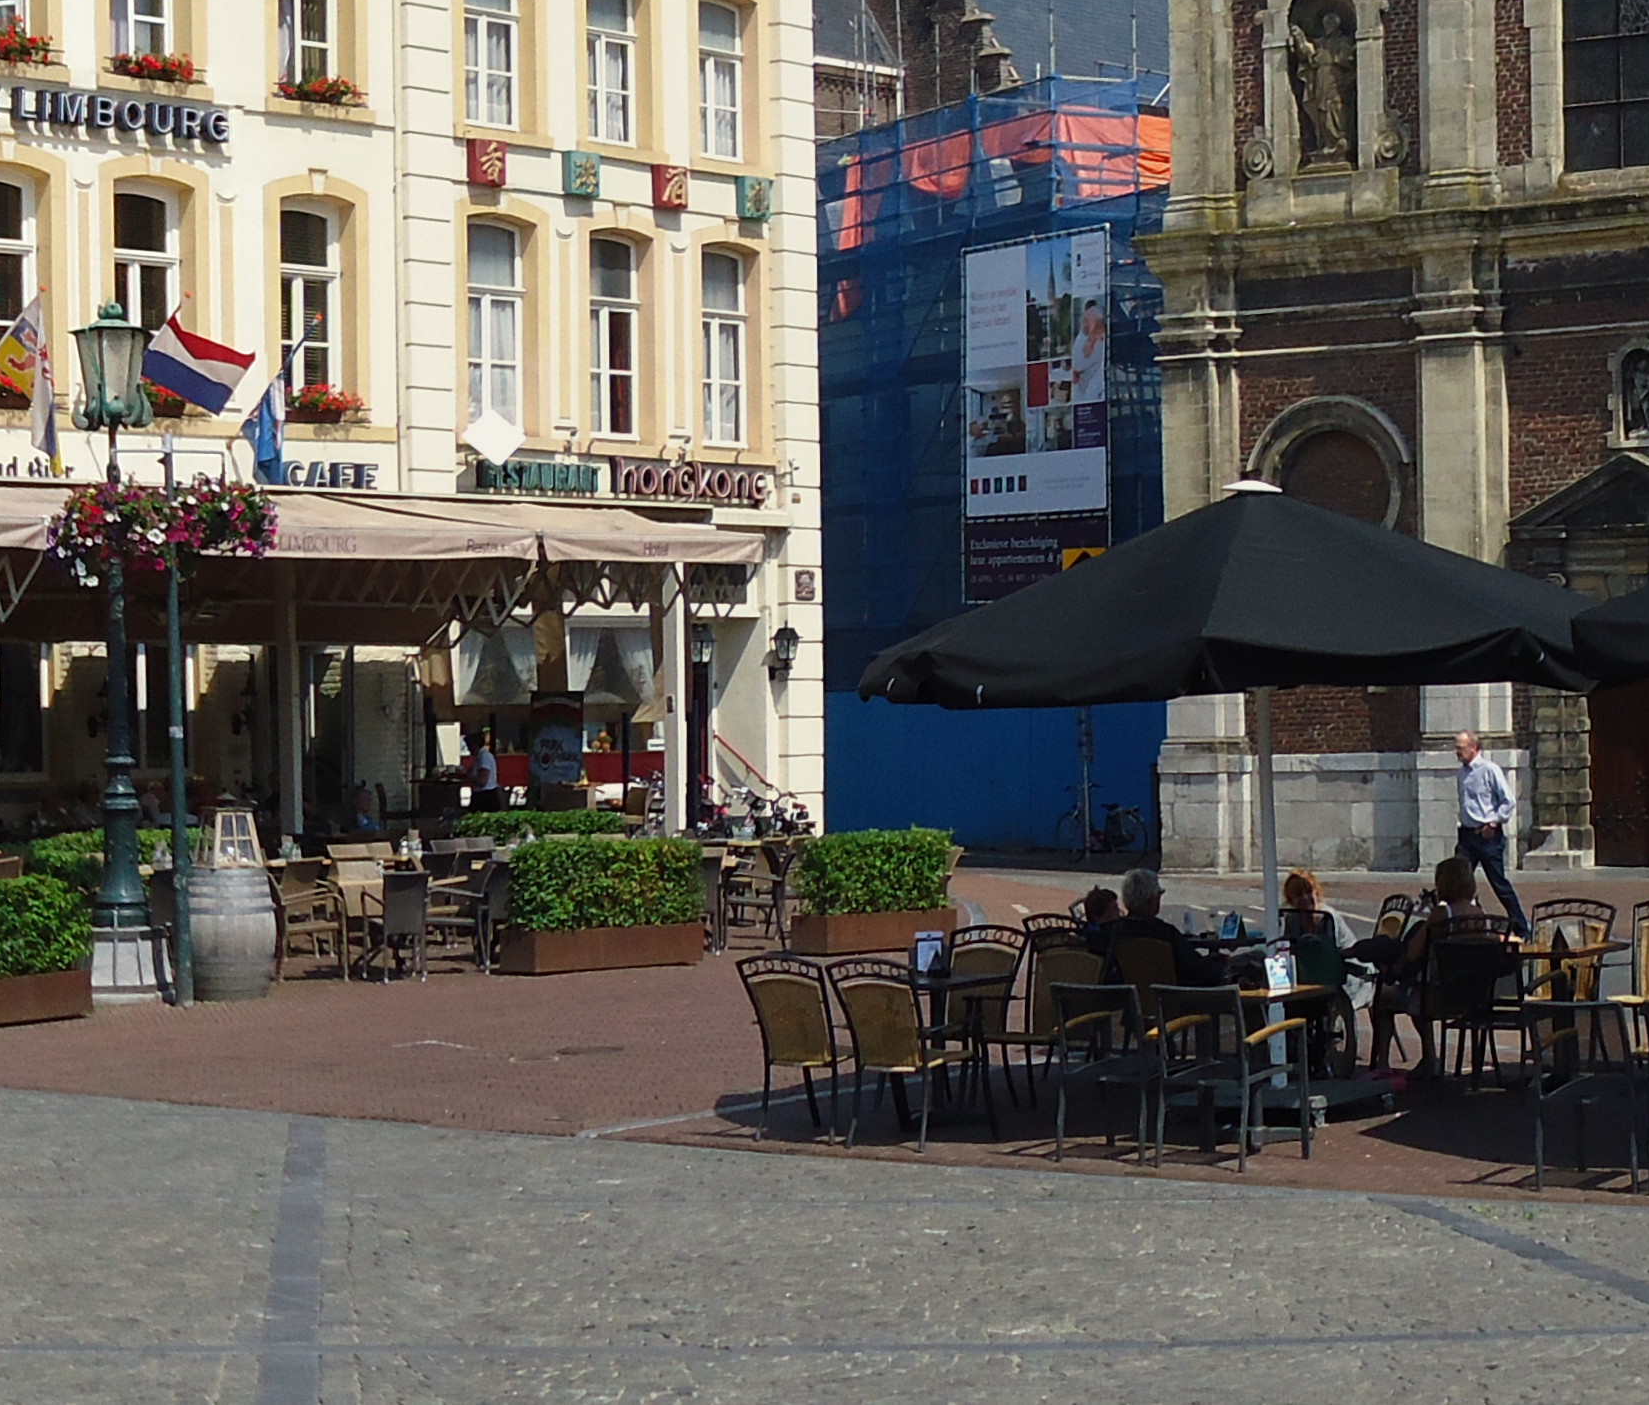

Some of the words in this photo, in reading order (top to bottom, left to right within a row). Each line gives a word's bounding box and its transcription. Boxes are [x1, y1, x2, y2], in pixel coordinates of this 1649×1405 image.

[12, 86, 230, 142] LIMBOURG
[28, 456, 75, 479] Bir
[609, 456, 768, 502] hongkong
[278, 534, 358, 554] LIMBOURG
[643, 543, 669, 556] Hotel
